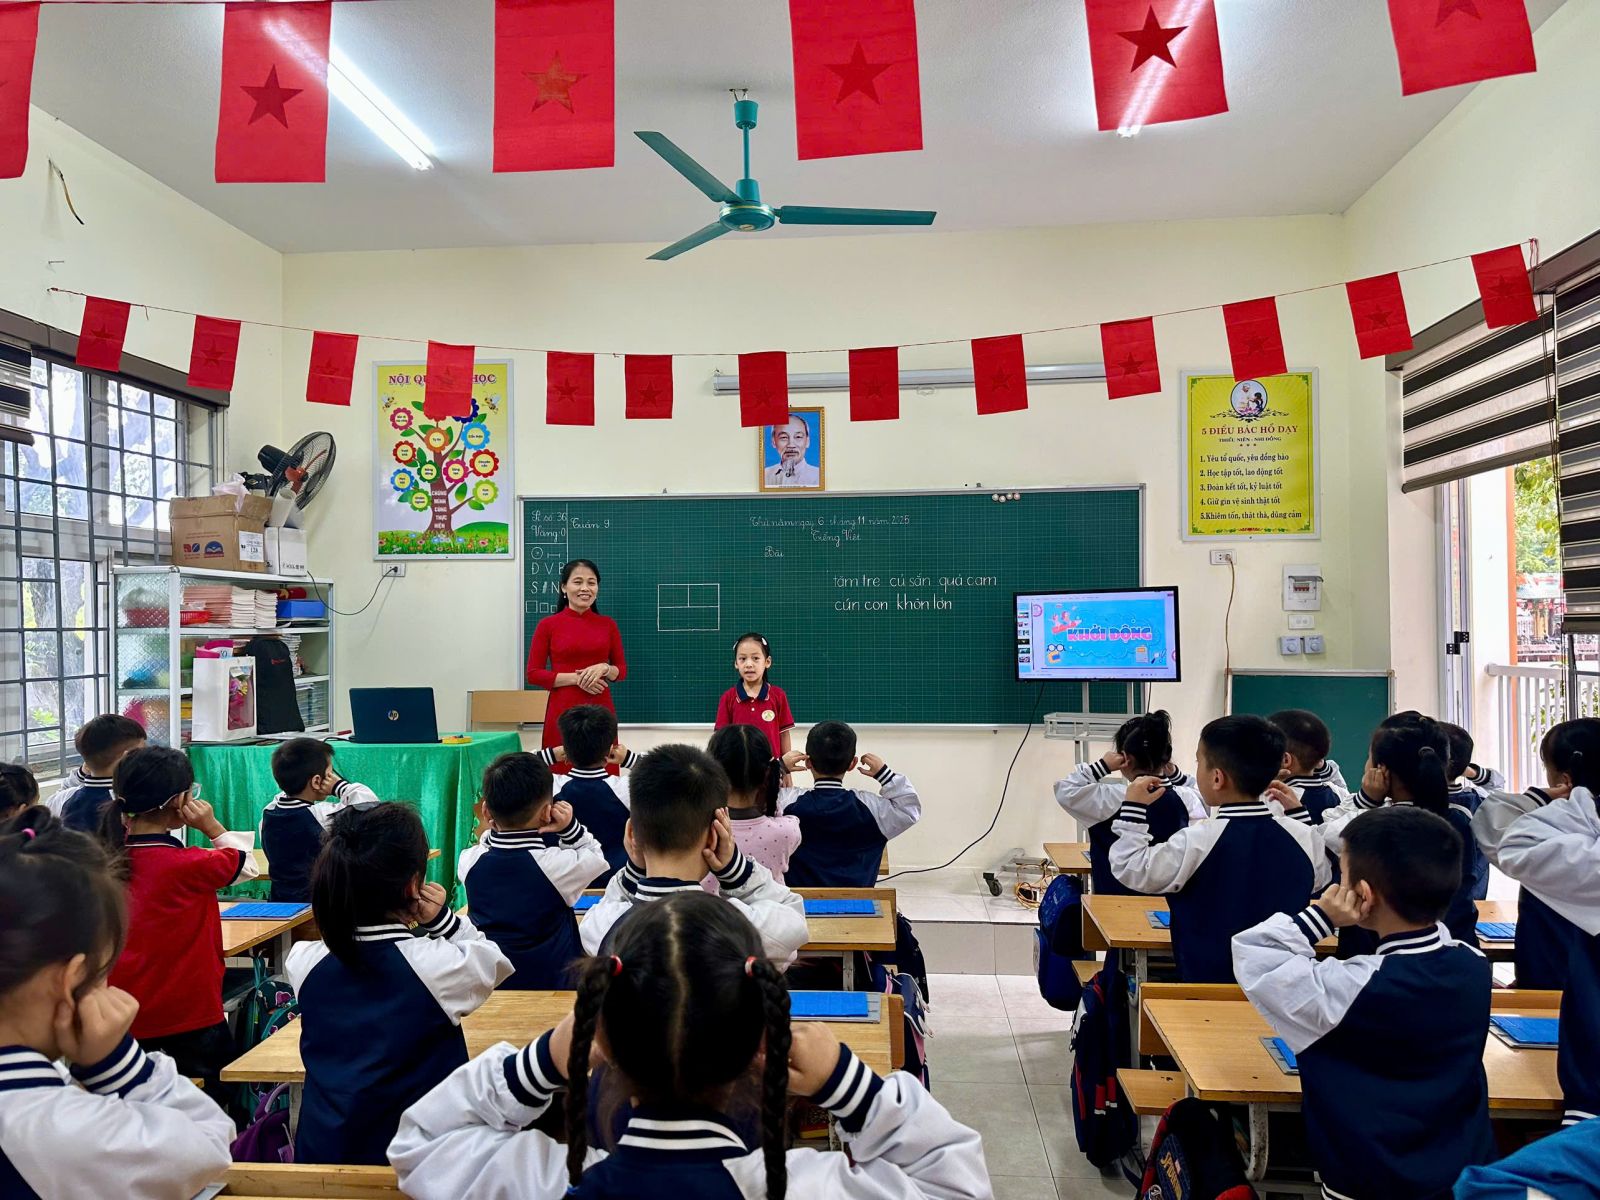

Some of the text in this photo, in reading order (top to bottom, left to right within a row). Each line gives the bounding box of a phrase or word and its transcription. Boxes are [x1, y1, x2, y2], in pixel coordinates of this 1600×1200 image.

[388, 373, 410, 387] NỘI
[1209, 424, 1234, 435] ĐIỀU
[1237, 425, 1257, 434] BÁC
[1260, 423, 1275, 433] HỒ
[1278, 426, 1298, 435] DẠY
[1228, 454, 1245, 463] quốc,
[1247, 454, 1259, 463] yêu
[1260, 452, 1276, 462] đồng
[1207, 469, 1219, 478] Học
[1221, 469, 1231, 478] tập
[1233, 468, 1244, 476] tốt,
[1256, 468, 1272, 477] động
[1274, 467, 1283, 475] tốt
[1226, 482, 1236, 490] kết
[1237, 482, 1248, 491] tốt,
[1259, 482, 1272, 491] luật
[1273, 481, 1282, 489] tốt
[1207, 497, 1219, 505] Giữ
[1232, 498, 1240, 506] vệ
[1241, 497, 1255, 505] sinh
[1256, 497, 1269, 505] thật
[1271, 495, 1280, 503] tốt
[1242, 511, 1255, 520] thật
[1271, 510, 1287, 519] dũng
[1288, 509, 1302, 518] cảm
[604, 519, 610, 528] 9
[817, 516, 825, 526] 6
[857, 515, 865, 525] 11
[544, 562, 554, 575] V
[862, 574, 881, 587] tre
[966, 576, 997, 586] cam
[834, 593, 952, 611] cún con khôn lớn
[1067, 624, 1152, 643] KHỞI ĐỘNG
